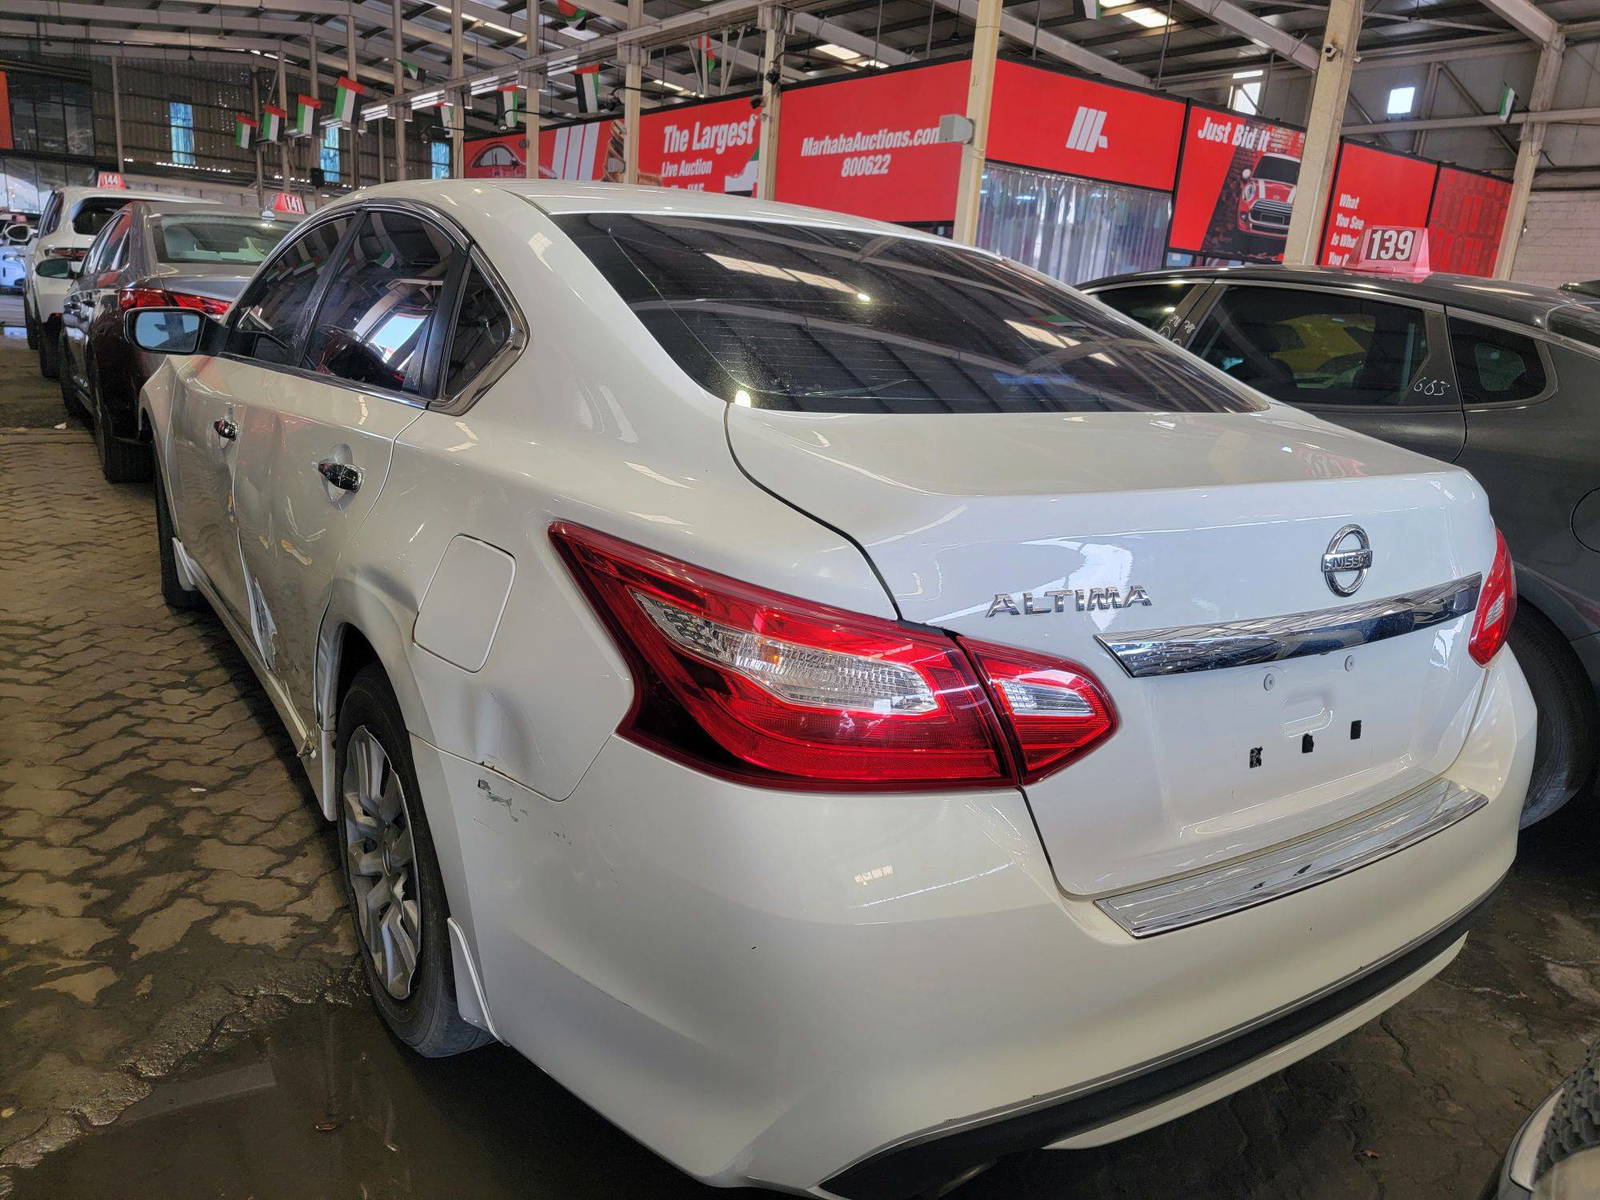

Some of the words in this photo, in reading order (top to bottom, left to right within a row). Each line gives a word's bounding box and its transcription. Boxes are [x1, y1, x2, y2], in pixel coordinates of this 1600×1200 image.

[663, 124, 689, 154] The
[691, 114, 757, 155] Largest
[800, 126, 940, 157] MarhabaAuctions.com
[1197, 117, 1232, 144] Just
[1231, 123, 1258, 149] Bid
[661, 162, 678, 178] Live
[679, 158, 713, 177] Auction
[841, 154, 891, 178] 800622
[102, 175, 119, 186] 144
[285, 197, 301, 212] 141
[1338, 193, 1360, 210] What
[1335, 213, 1350, 228] You
[1349, 215, 1365, 231] See
[1370, 230, 1414, 260] 139
[985, 584, 1152, 619] ALTIMA
